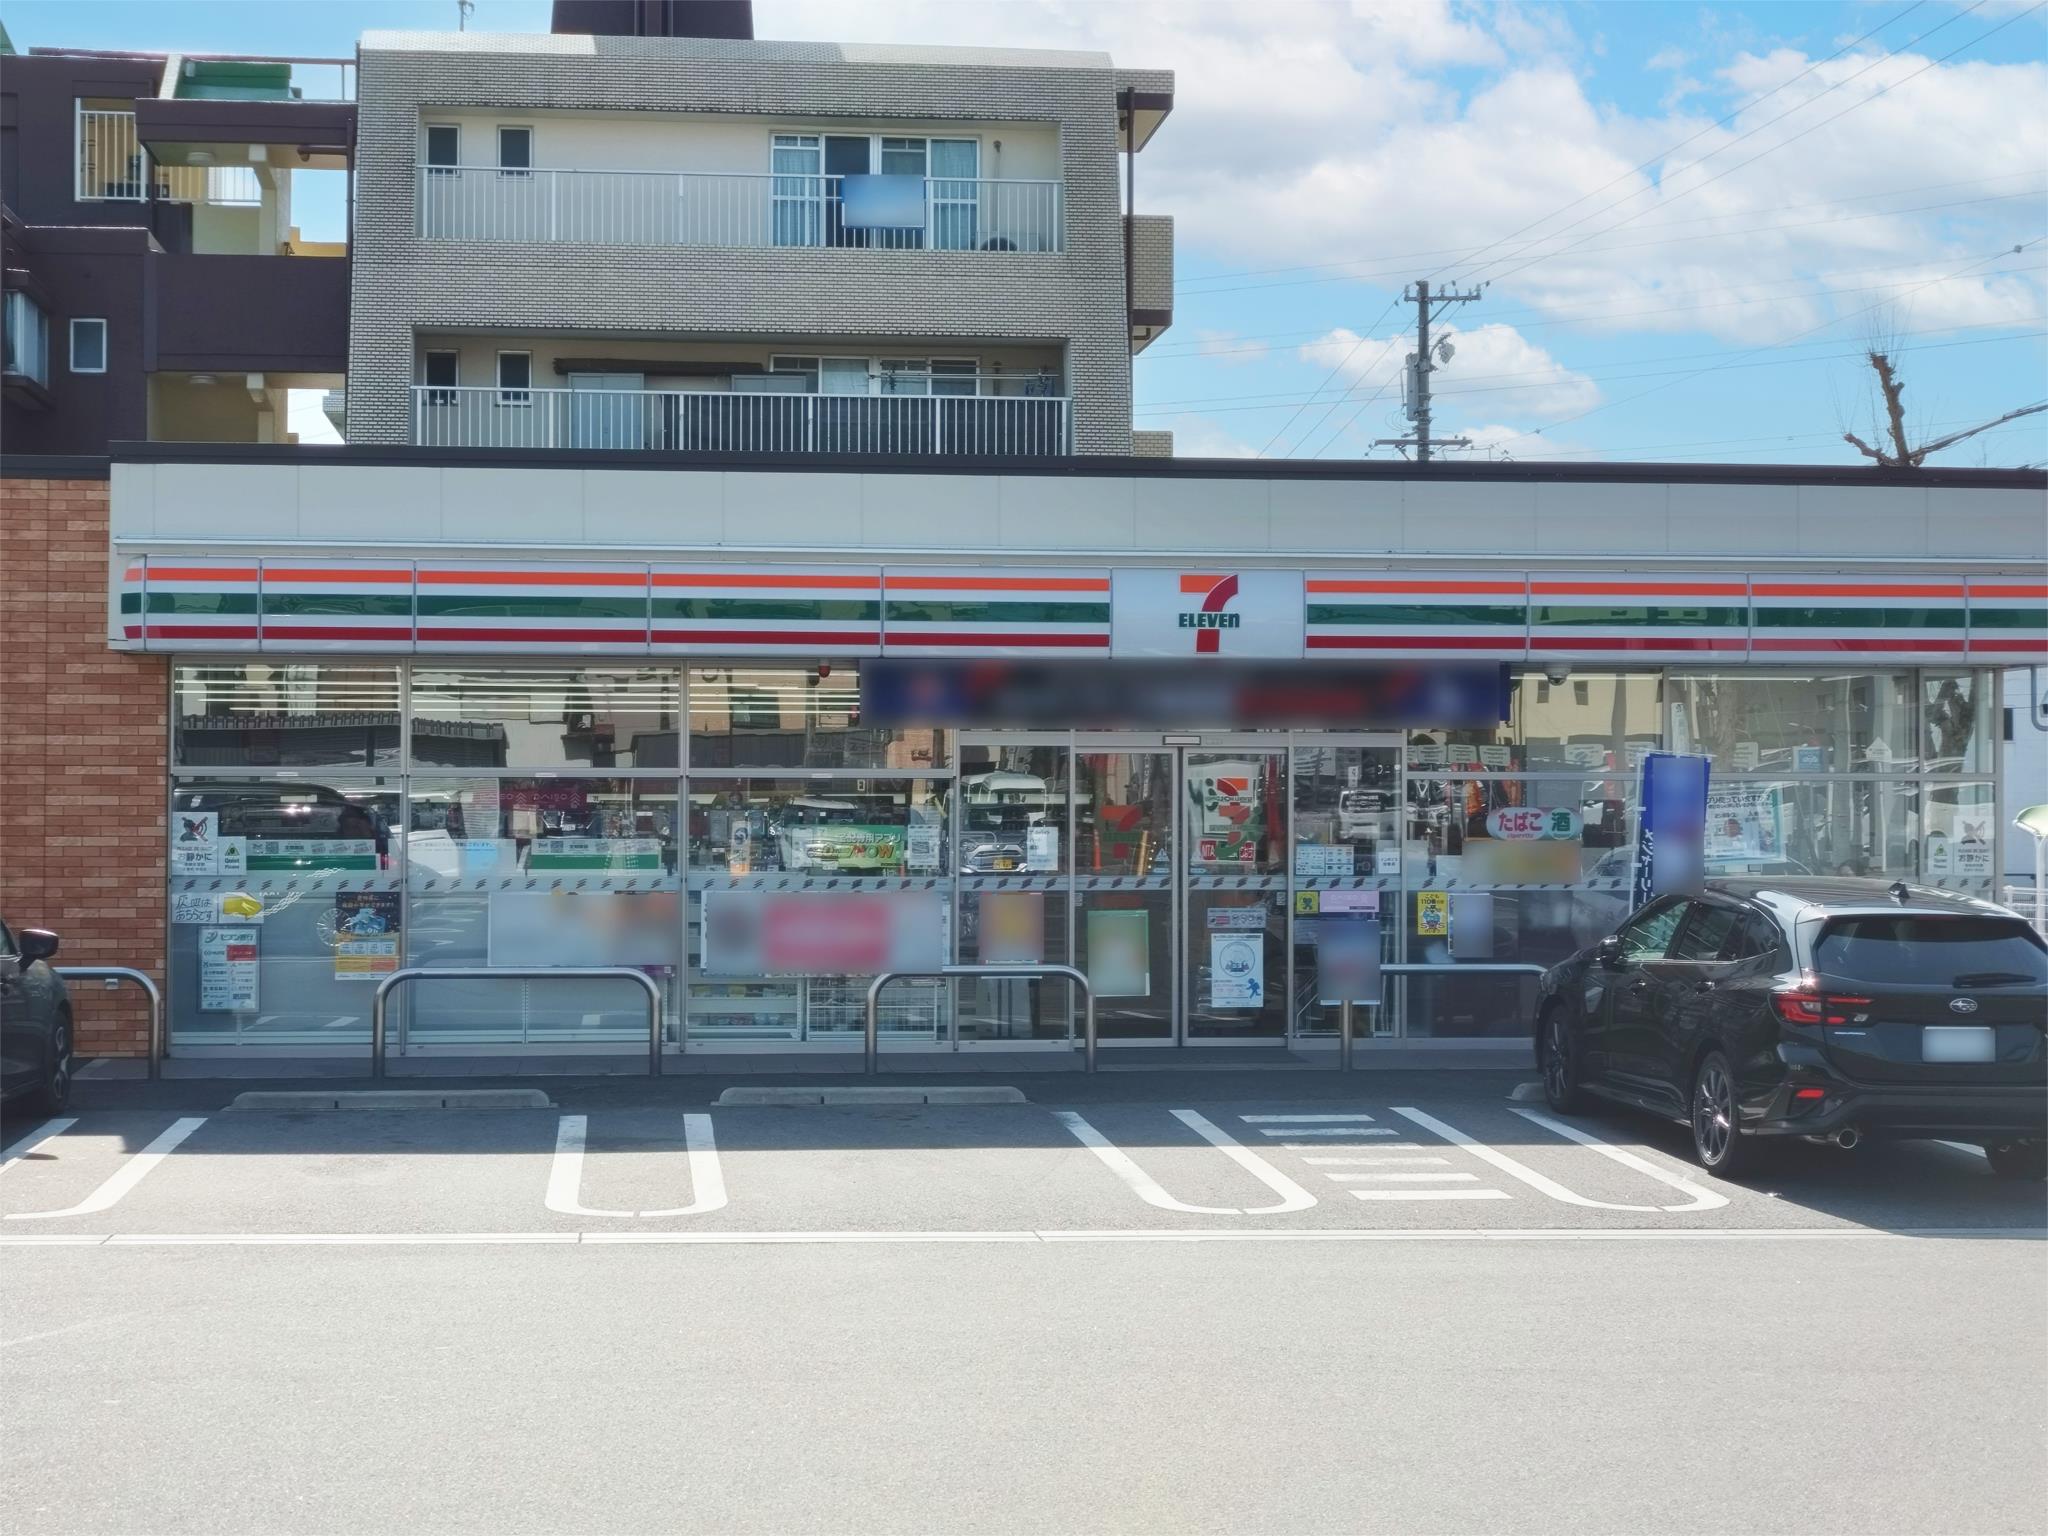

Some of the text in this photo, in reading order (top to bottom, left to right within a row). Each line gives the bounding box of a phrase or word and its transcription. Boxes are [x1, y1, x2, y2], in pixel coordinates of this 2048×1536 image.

[1498, 811, 1571, 832] たばこ 酒
